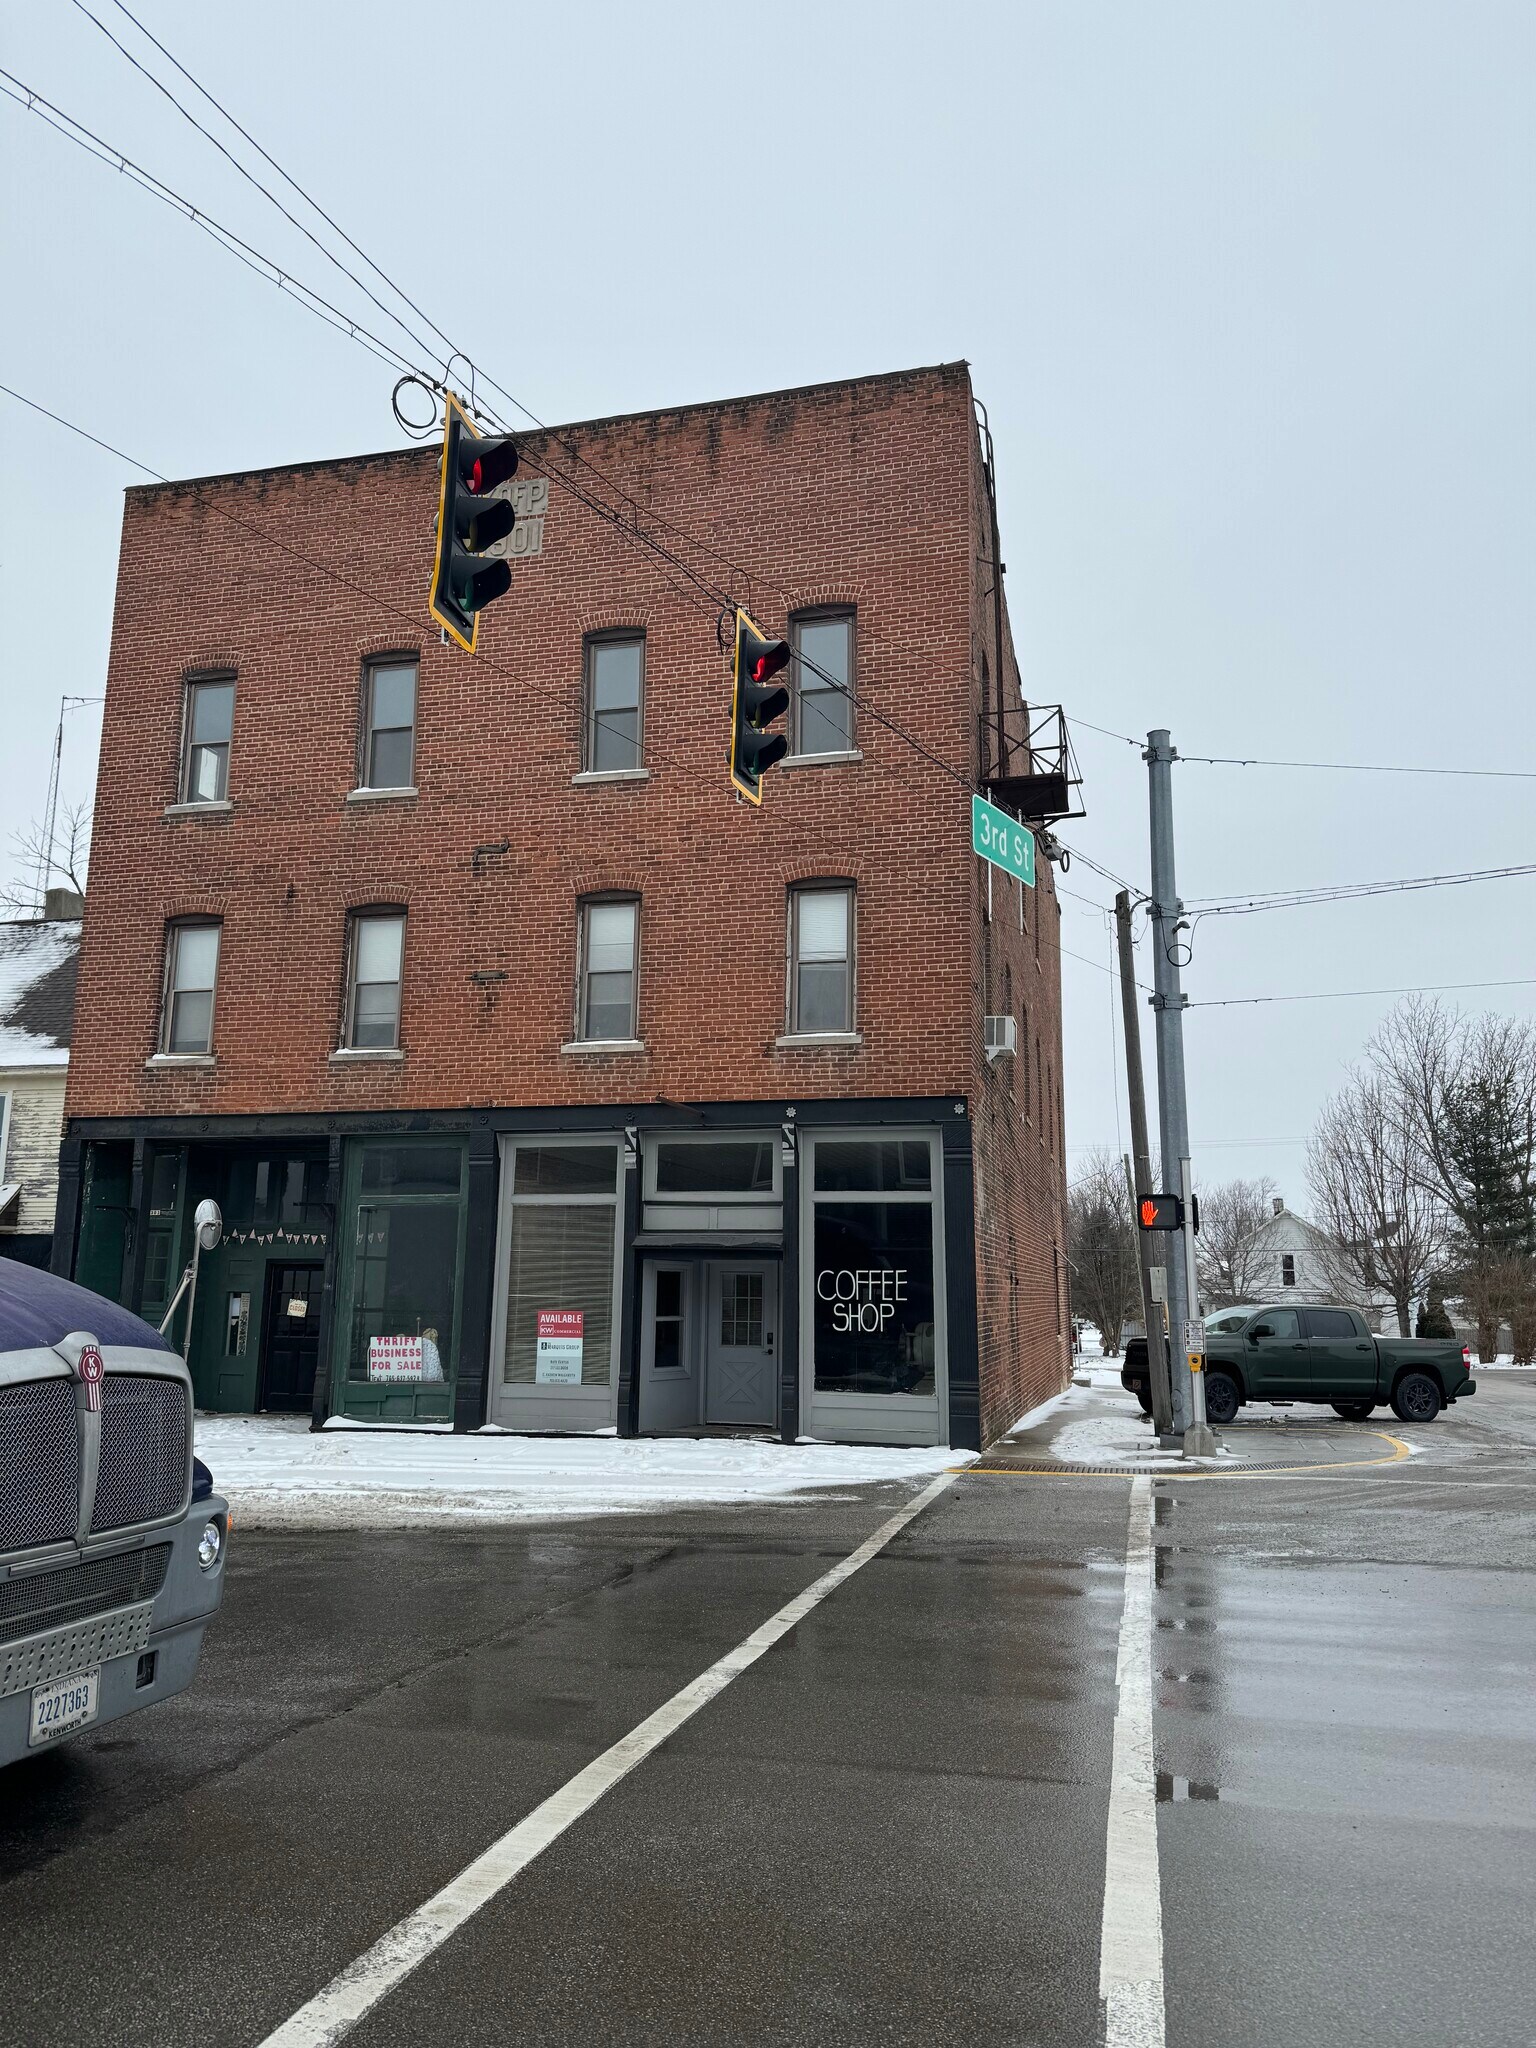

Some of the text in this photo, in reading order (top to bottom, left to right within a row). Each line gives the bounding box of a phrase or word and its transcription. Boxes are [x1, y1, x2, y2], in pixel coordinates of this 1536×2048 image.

[980, 812, 1029, 872] 3rd St
[817, 1269, 908, 1301] COFFEE
[540, 1314, 582, 1324] AVAILABLE
[832, 1303, 895, 1332] SHOP
[376, 1337, 417, 1346] THRIFT
[370, 1348, 422, 1358] BUSINESS
[371, 1360, 422, 1371] FOR SALE
[38, 1685, 89, 1726] 2227363
[48, 1718, 82, 1738] KENWORTH
